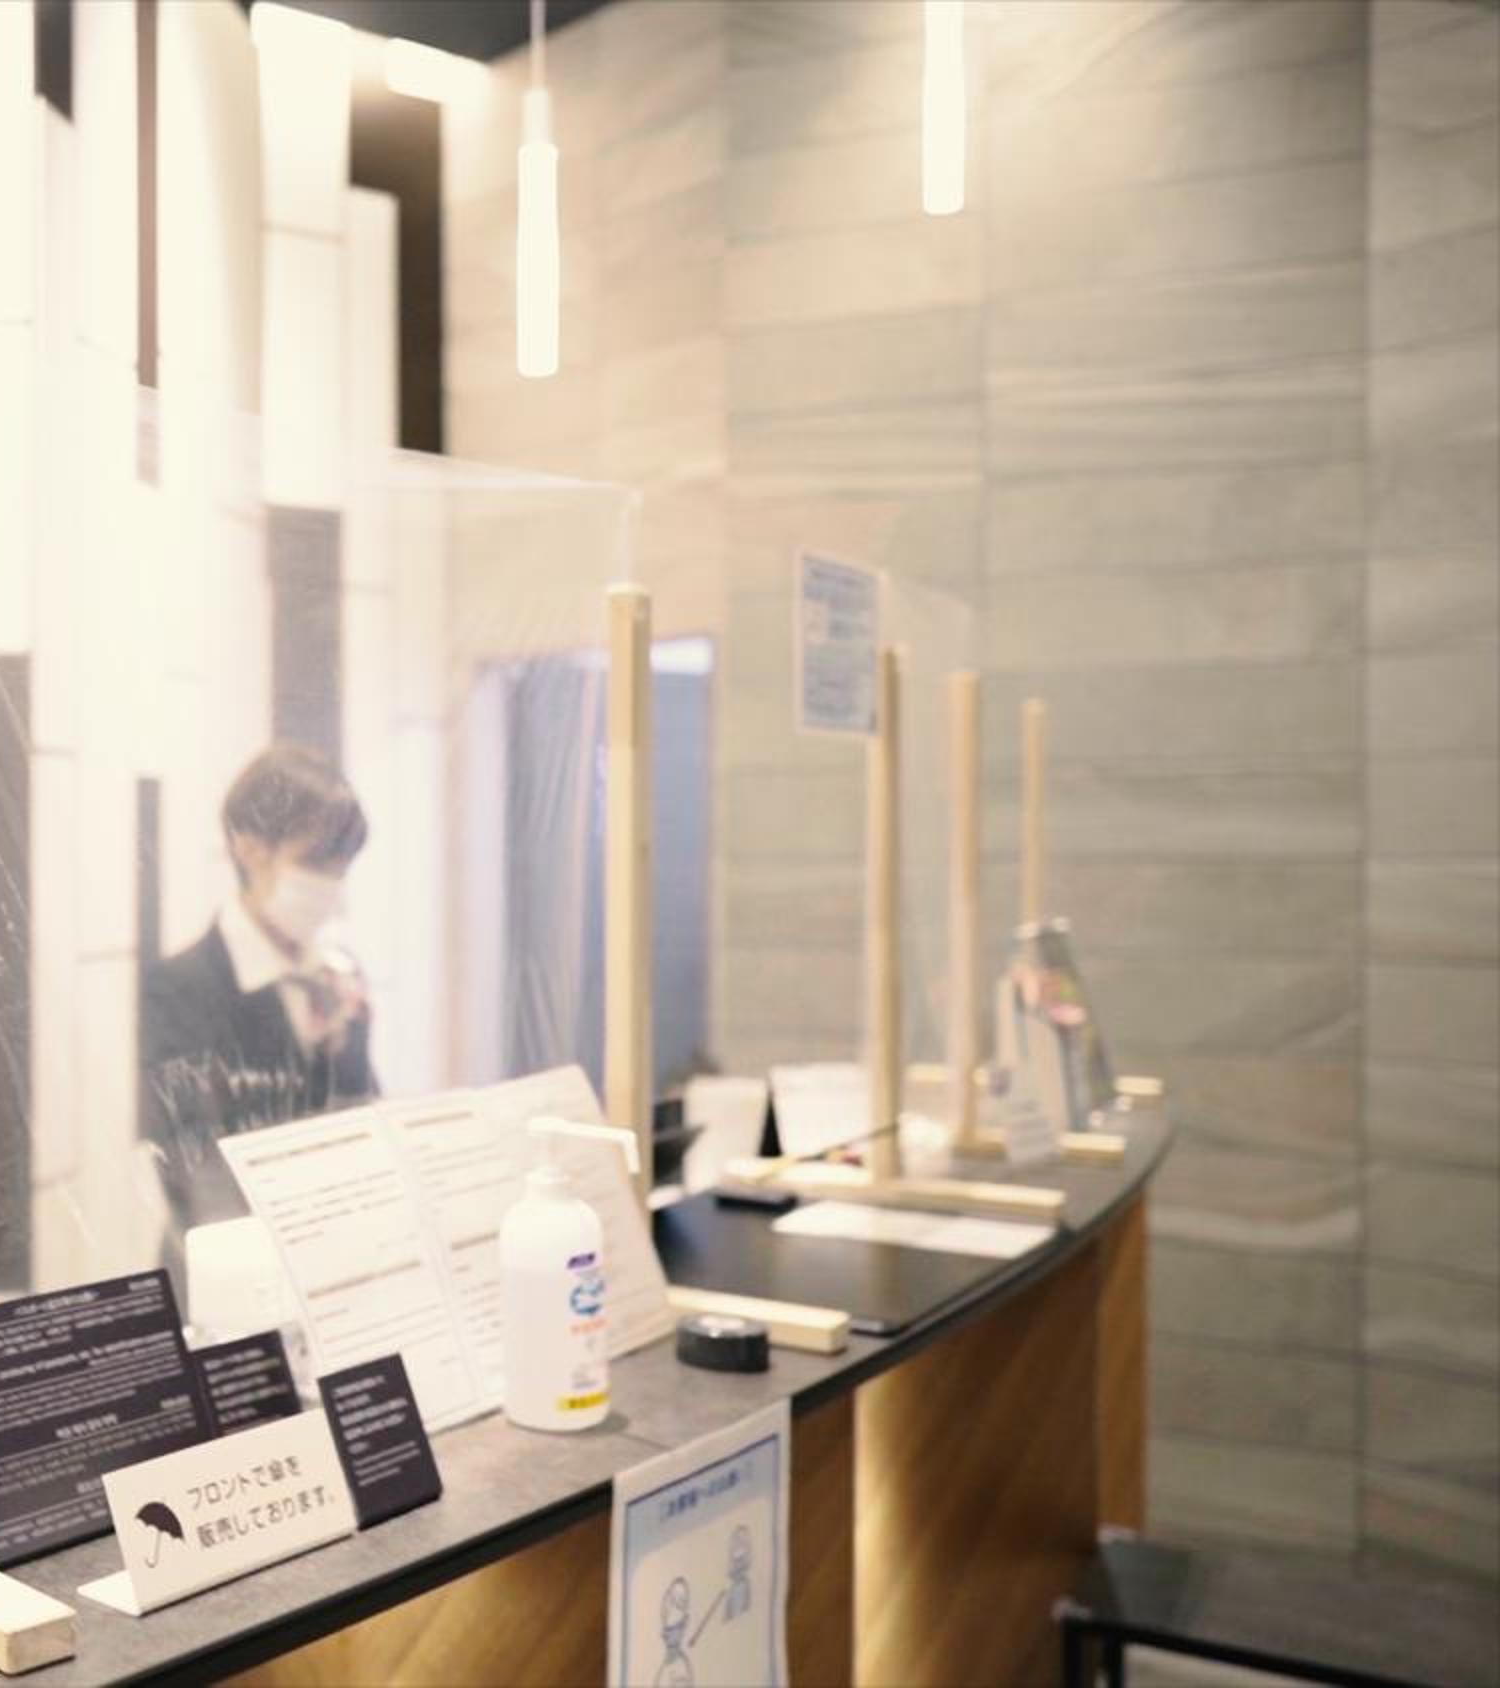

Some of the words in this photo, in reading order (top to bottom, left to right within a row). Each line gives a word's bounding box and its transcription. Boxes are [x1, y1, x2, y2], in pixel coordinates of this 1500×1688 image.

[187, 1455, 301, 1510] フロントで傘を
[197, 1485, 335, 1550] 販売しております。
